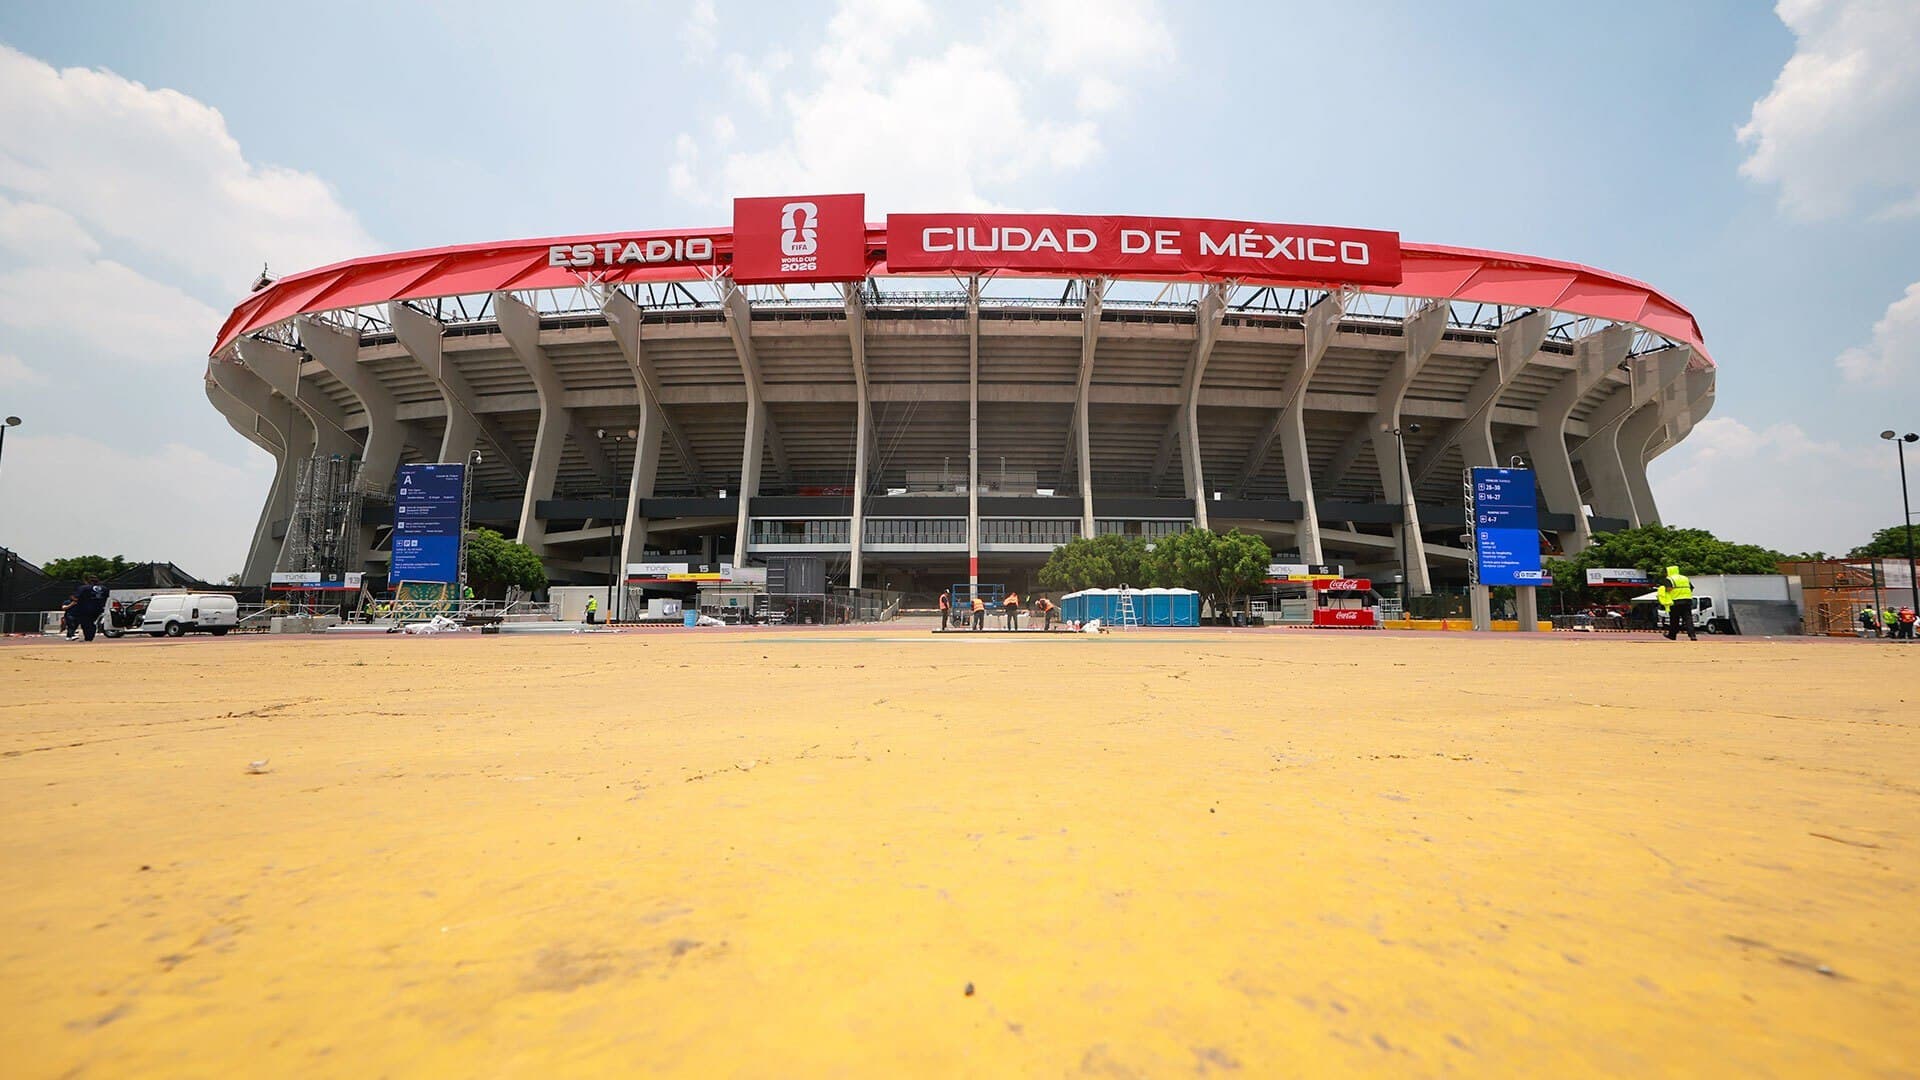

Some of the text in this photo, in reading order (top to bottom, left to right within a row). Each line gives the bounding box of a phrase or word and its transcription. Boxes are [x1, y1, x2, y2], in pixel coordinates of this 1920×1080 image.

[922, 226, 1369, 266] CIUDAD DE MÉXICO
[549, 238, 713, 267] ESTADIO
[781, 263, 817, 272] 2026
[403, 475, 412, 485] A
[699, 565, 709, 573] 15
[721, 567, 730, 576] 15
[1319, 566, 1329, 574] 16
[348, 576, 361, 585] 13
[1329, 579, 1358, 590] Coca-Cola
[1336, 611, 1358, 620] Coca-Cola
